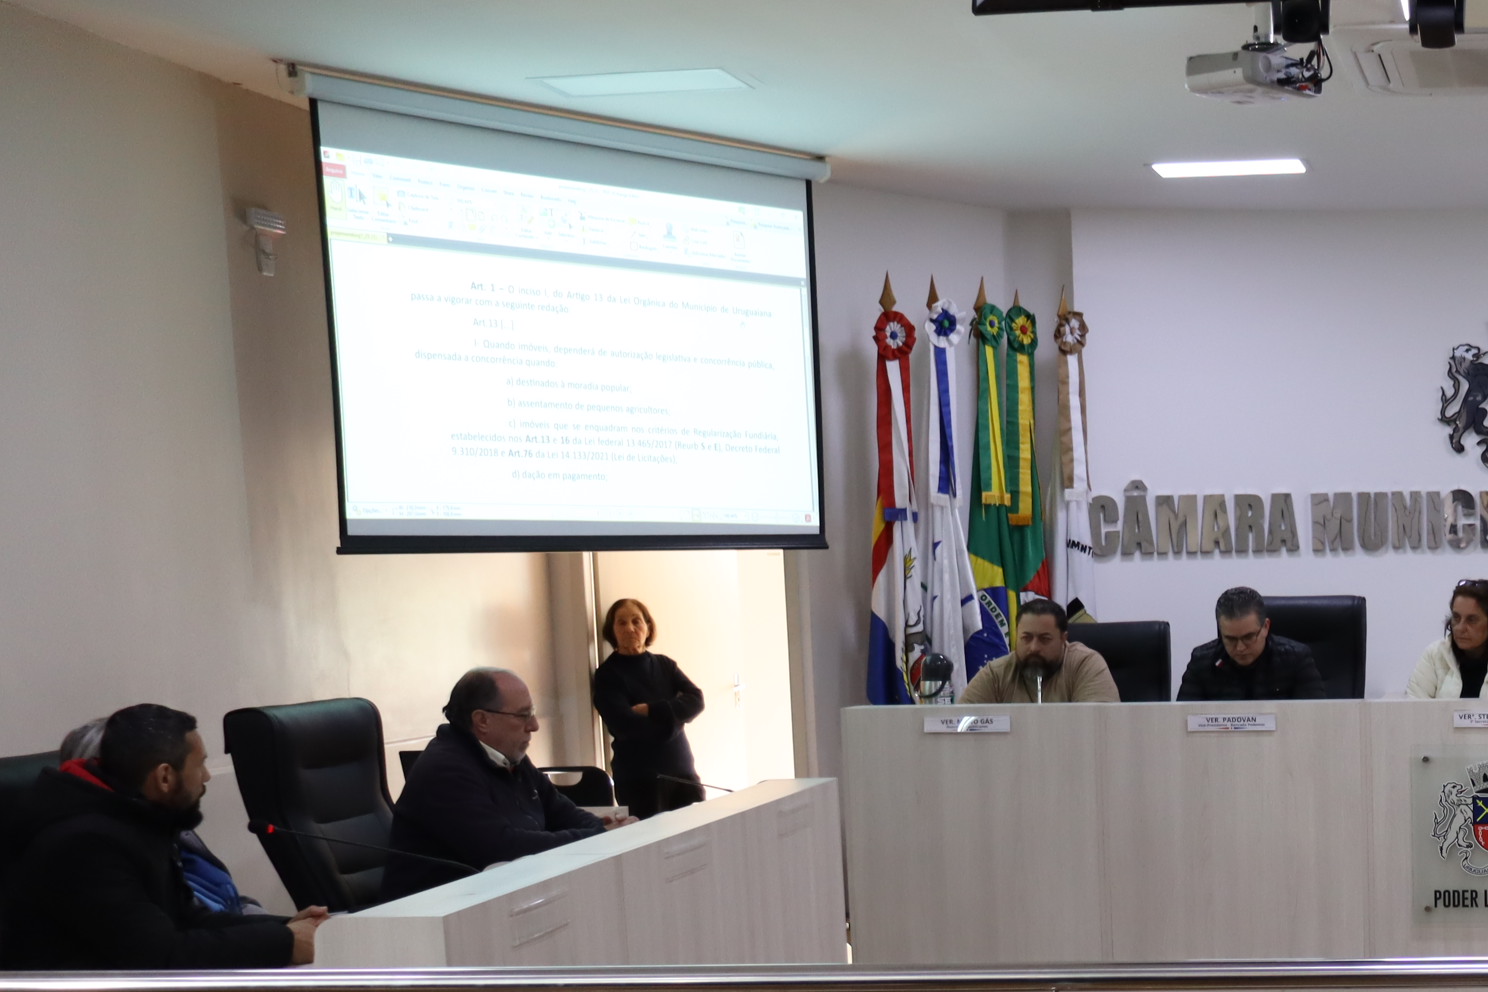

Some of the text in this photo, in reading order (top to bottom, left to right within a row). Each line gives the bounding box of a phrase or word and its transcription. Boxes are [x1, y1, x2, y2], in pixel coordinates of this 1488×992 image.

[411, 293, 434, 302] passa
[444, 296, 472, 304] vigorar
[502, 300, 535, 311] seguinte
[508, 285, 514, 293] O
[519, 287, 540, 296] inciso
[553, 289, 563, 298] do
[567, 291, 590, 301] Artigo
[594, 294, 603, 302] 13
[607, 295, 616, 303] da
[620, 296, 630, 304] Lei
[634, 297, 665, 307] Orgânica
[669, 300, 678, 308] do
[682, 302, 717, 313] Município
[721, 305, 728, 313] de
[415, 349, 461, 362] dispensada
[471, 356, 522, 365] concorrência
[483, 340, 515, 350] Quando
[554, 345, 595, 355] dependerá
[598, 348, 607, 356] de
[611, 350, 653, 361] autorização
[656, 353, 691, 364] legislativa
[701, 357, 745, 367] concorrência
[507, 377, 513, 386] a)
[516, 378, 558, 388] destinados
[568, 381, 598, 391] moradia
[508, 398, 515, 408] b)
[518, 400, 572, 409] assentamento
[575, 402, 584, 410] de
[587, 404, 624, 413] pequenos
[520, 420, 549, 429] imóveis
[585, 424, 628, 433] enquadram
[648, 427, 677, 435] critérios
[694, 429, 741, 439] Regularização
[451, 432, 505, 442] estabelecidos
[598, 438, 623, 447] federal
[755, 446, 780, 454] Federal
[548, 451, 558, 459] Lei
[627, 454, 635, 462] de
[512, 470, 520, 480] d)
[522, 471, 545, 480] dação
[1088, 479, 1300, 557] CÂMARA
[980, 594, 1006, 628] ORDEM
[1434, 889, 1479, 908] PODER
